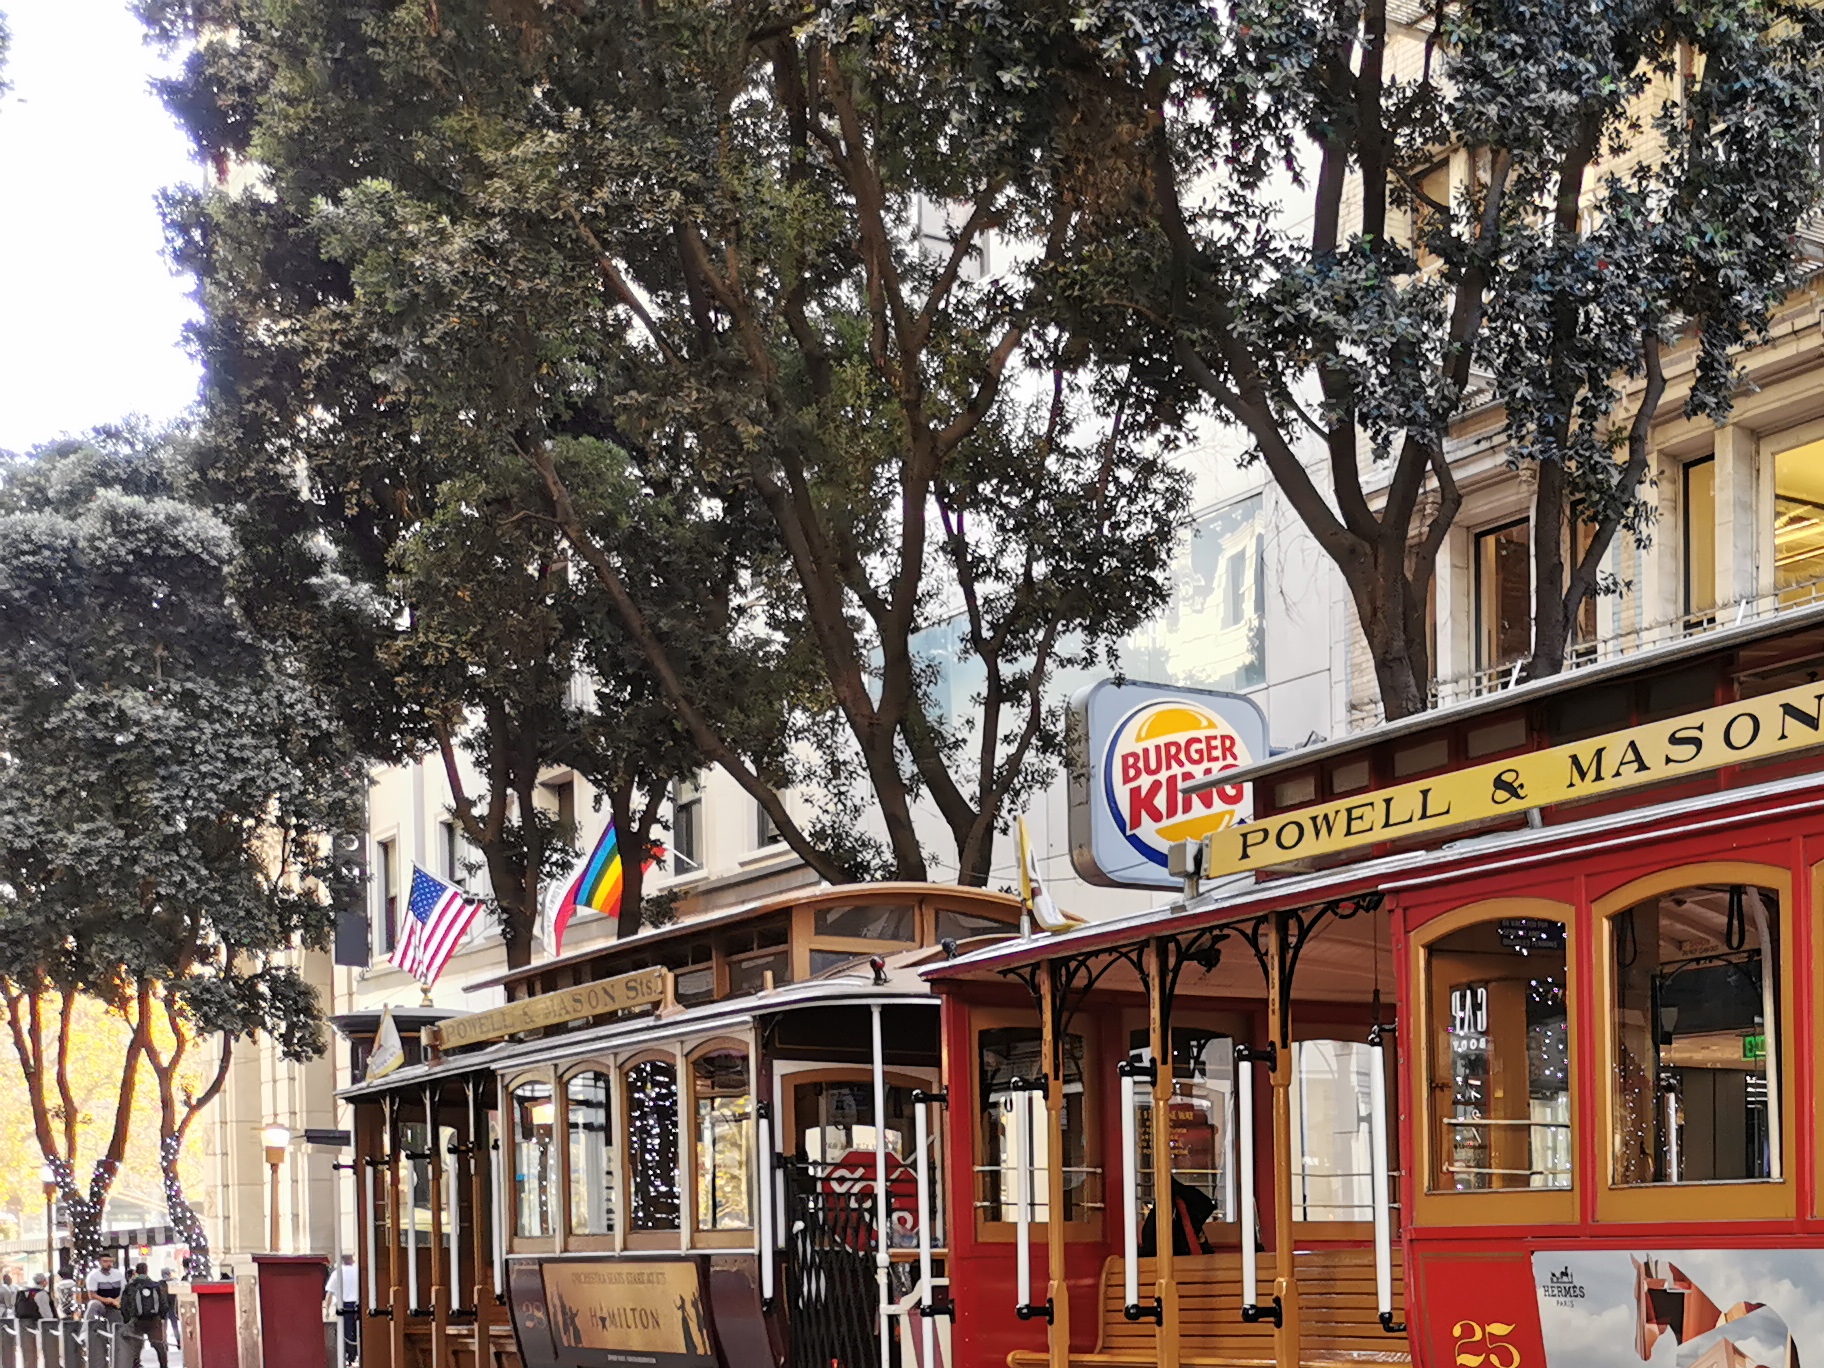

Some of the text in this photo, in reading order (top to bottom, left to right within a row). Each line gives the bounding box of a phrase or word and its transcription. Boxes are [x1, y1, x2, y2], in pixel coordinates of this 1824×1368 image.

[1121, 734, 1239, 786] BURGER
[1236, 786, 1453, 862] POWELL
[1490, 767, 1527, 805] &
[1566, 693, 1824, 789] MASON
[1128, 764, 1244, 832] KING
[445, 1008, 515, 1043] POWELL
[545, 984, 617, 1020] MASON
